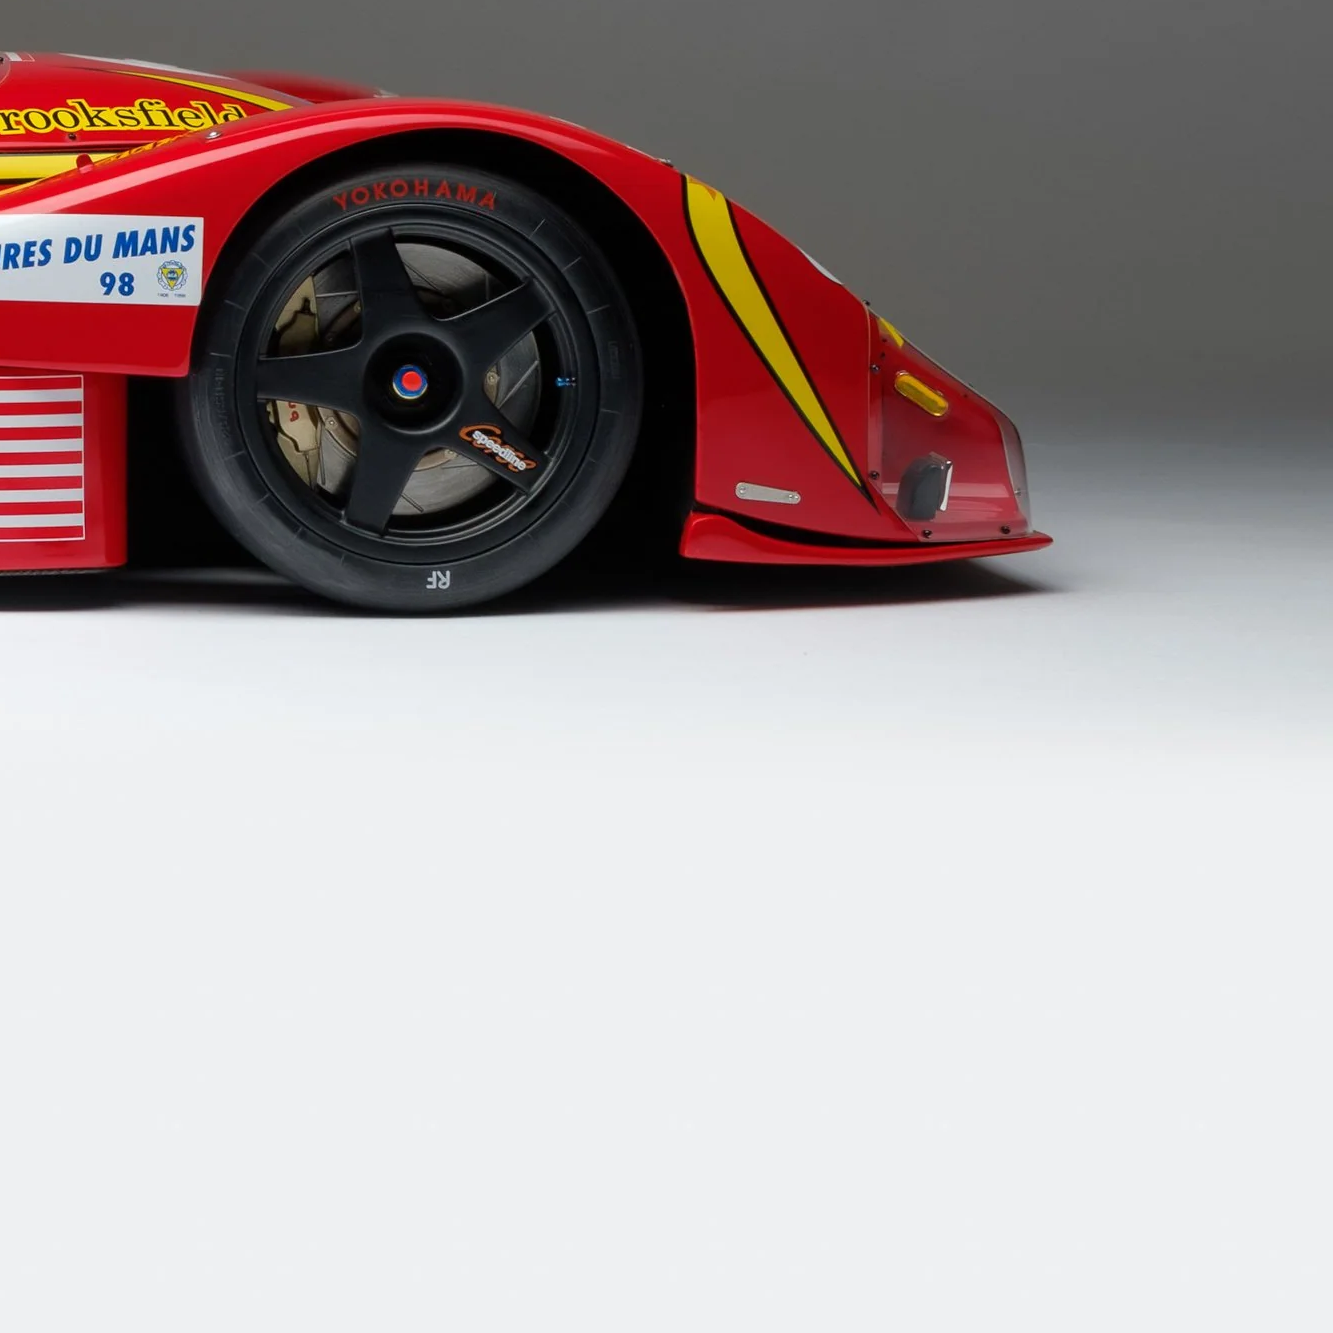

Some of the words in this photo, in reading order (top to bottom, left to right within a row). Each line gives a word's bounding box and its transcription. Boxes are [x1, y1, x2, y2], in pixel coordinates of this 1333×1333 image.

[334, 178, 497, 211] YOKOHAMA
[63, 234, 102, 262] DU
[112, 224, 196, 258] MANS
[99, 272, 135, 297] 98
[472, 430, 527, 471] speedline
[426, 570, 451, 590] RF
